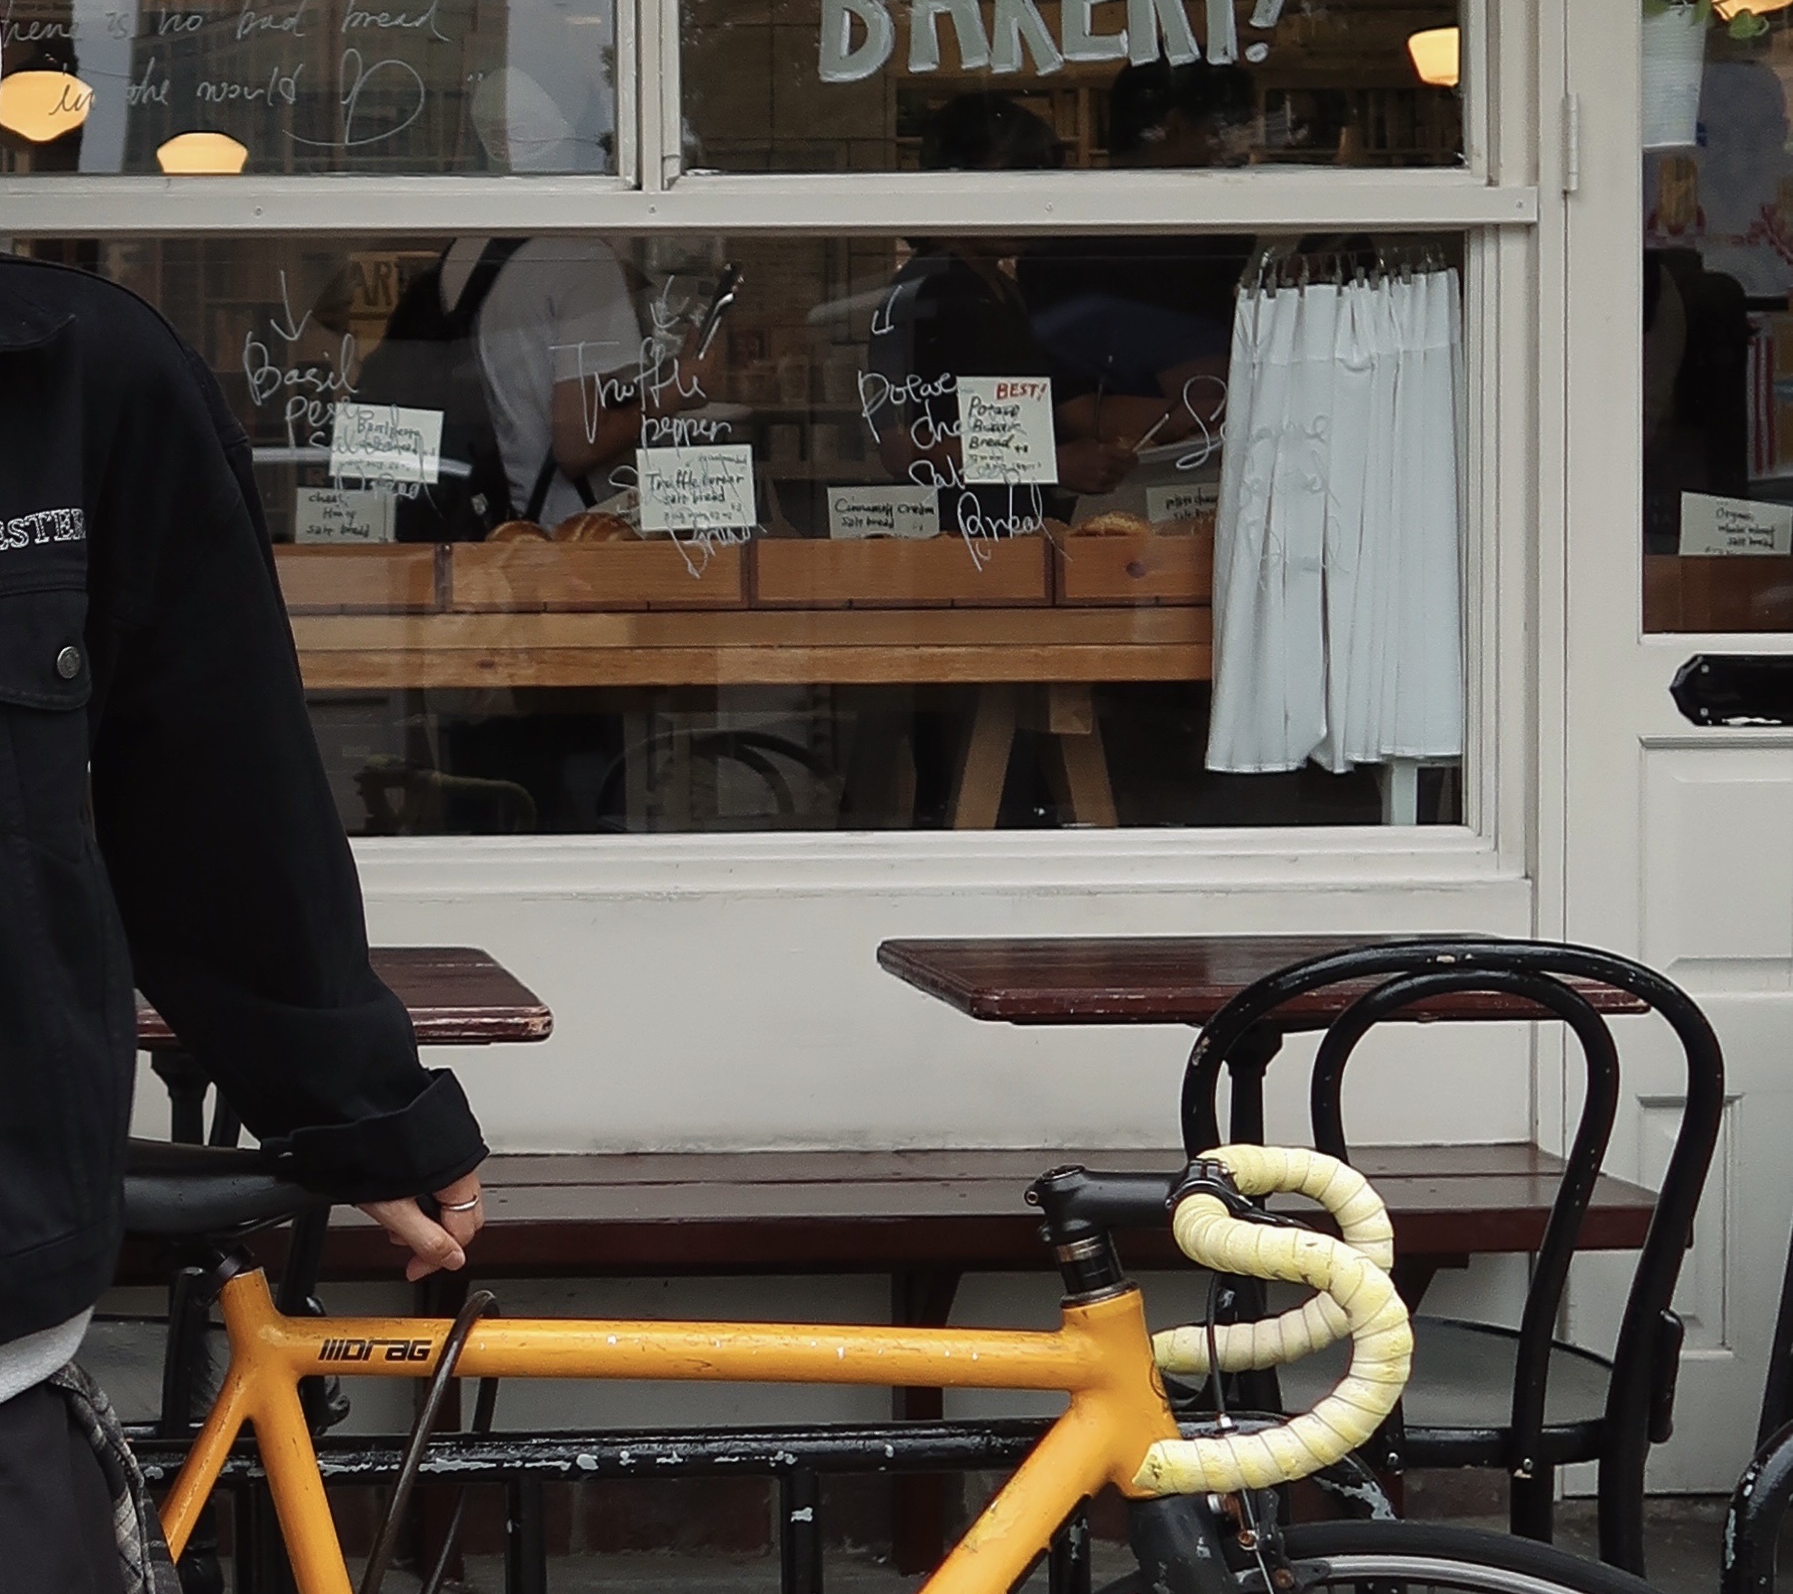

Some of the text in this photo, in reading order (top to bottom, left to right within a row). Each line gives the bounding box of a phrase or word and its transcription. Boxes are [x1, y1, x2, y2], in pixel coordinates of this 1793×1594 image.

[157, 8, 203, 36] no
[243, 331, 359, 405] Basil
[996, 381, 1048, 402] BEST!
